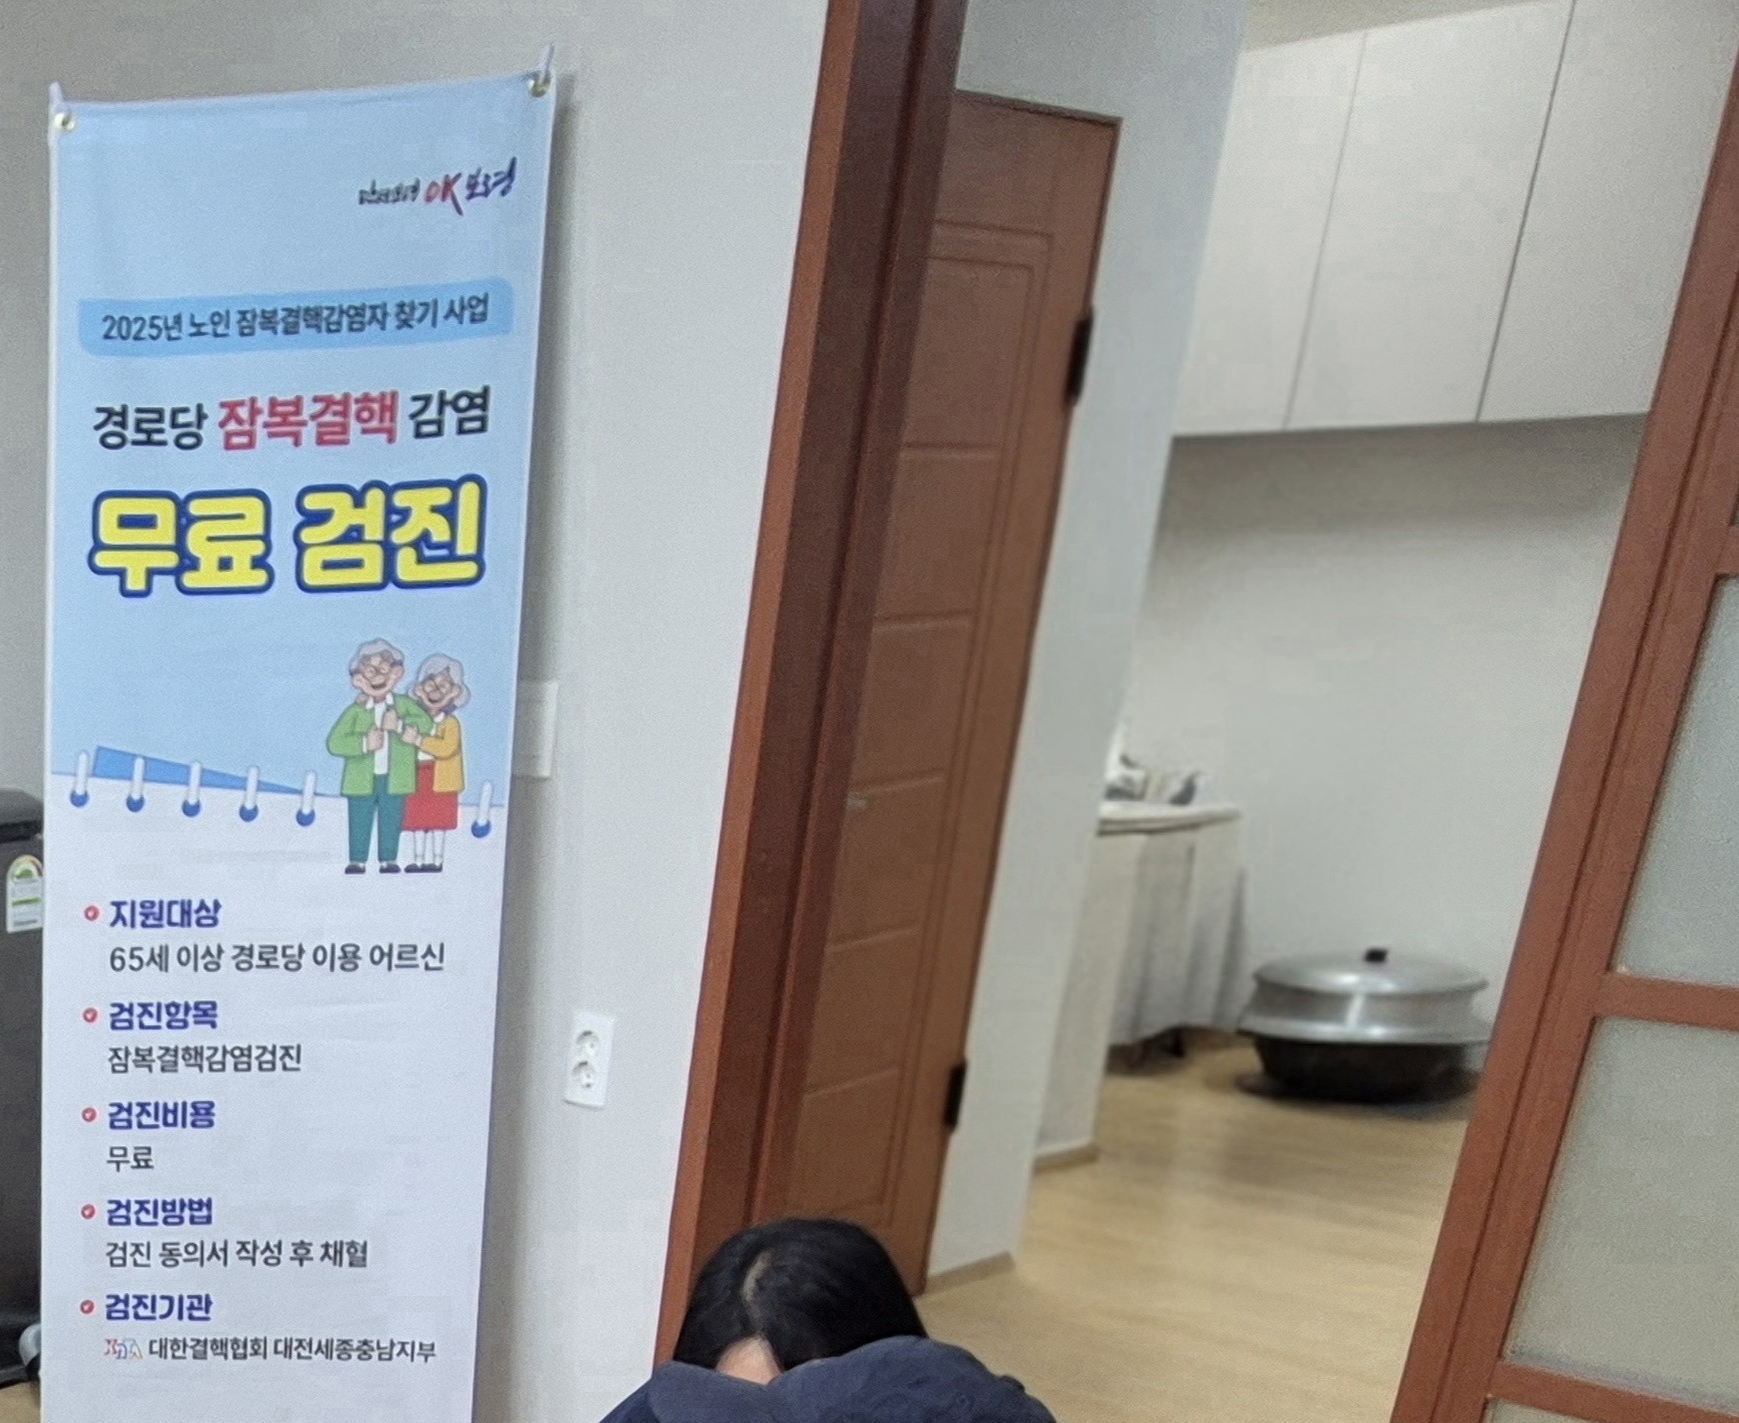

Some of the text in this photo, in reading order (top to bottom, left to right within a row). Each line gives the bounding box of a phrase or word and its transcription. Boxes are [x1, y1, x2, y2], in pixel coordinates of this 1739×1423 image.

[424, 172, 463, 216] OK
[102, 292, 489, 342] 2025년 노인 잠복결핵감염자 찾기 사업
[93, 385, 490, 451] 경로당 잠복결핵 감염
[87, 473, 488, 599] 무료 검진
[110, 899, 222, 929] 지원대상
[110, 942, 444, 973] 65세 이상 경로당 이용 어르신
[110, 1000, 217, 1031] 검진항목
[108, 1044, 301, 1074] 잠복결핵감염검진
[108, 1100, 216, 1130] 검진비용
[107, 1146, 154, 1172] 무료
[107, 1197, 213, 1227] 검진방법
[106, 1239, 368, 1268] 검진 동의서 작성 후 채혈
[106, 1293, 213, 1321] 검진기관
[148, 1337, 269, 1361] 대한결핵협회
[273, 1337, 435, 1363] 대전세종충남지부
